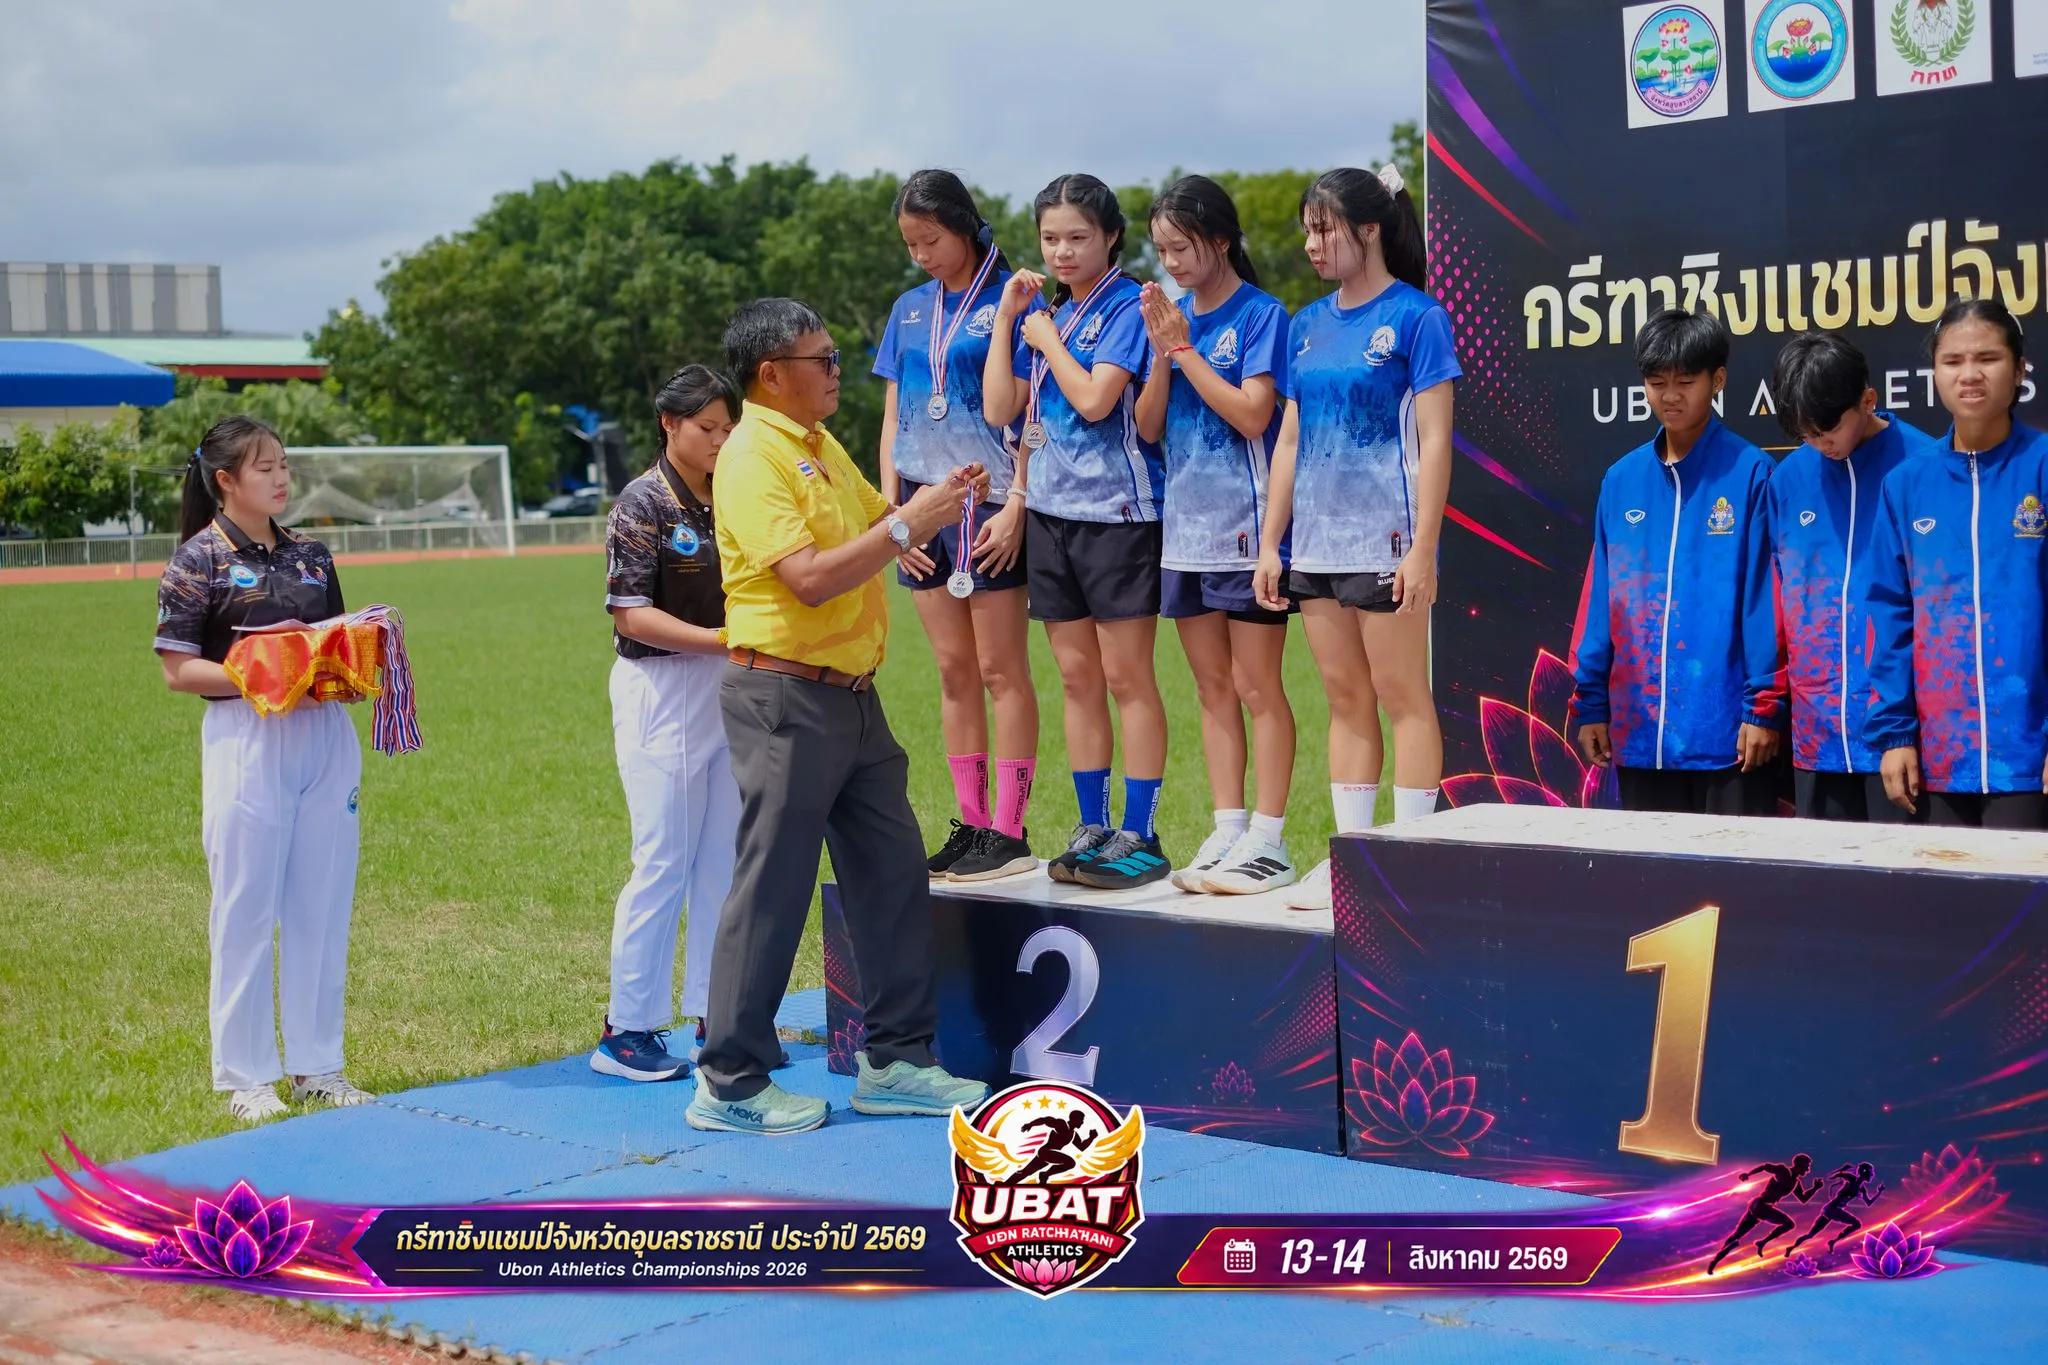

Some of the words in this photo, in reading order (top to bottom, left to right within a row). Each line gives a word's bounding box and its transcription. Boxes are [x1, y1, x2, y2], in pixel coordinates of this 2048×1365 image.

[1010, 925, 1101, 1087] 2
[1618, 906, 1720, 1166] 1
[726, 1104, 765, 1125] HOKA
